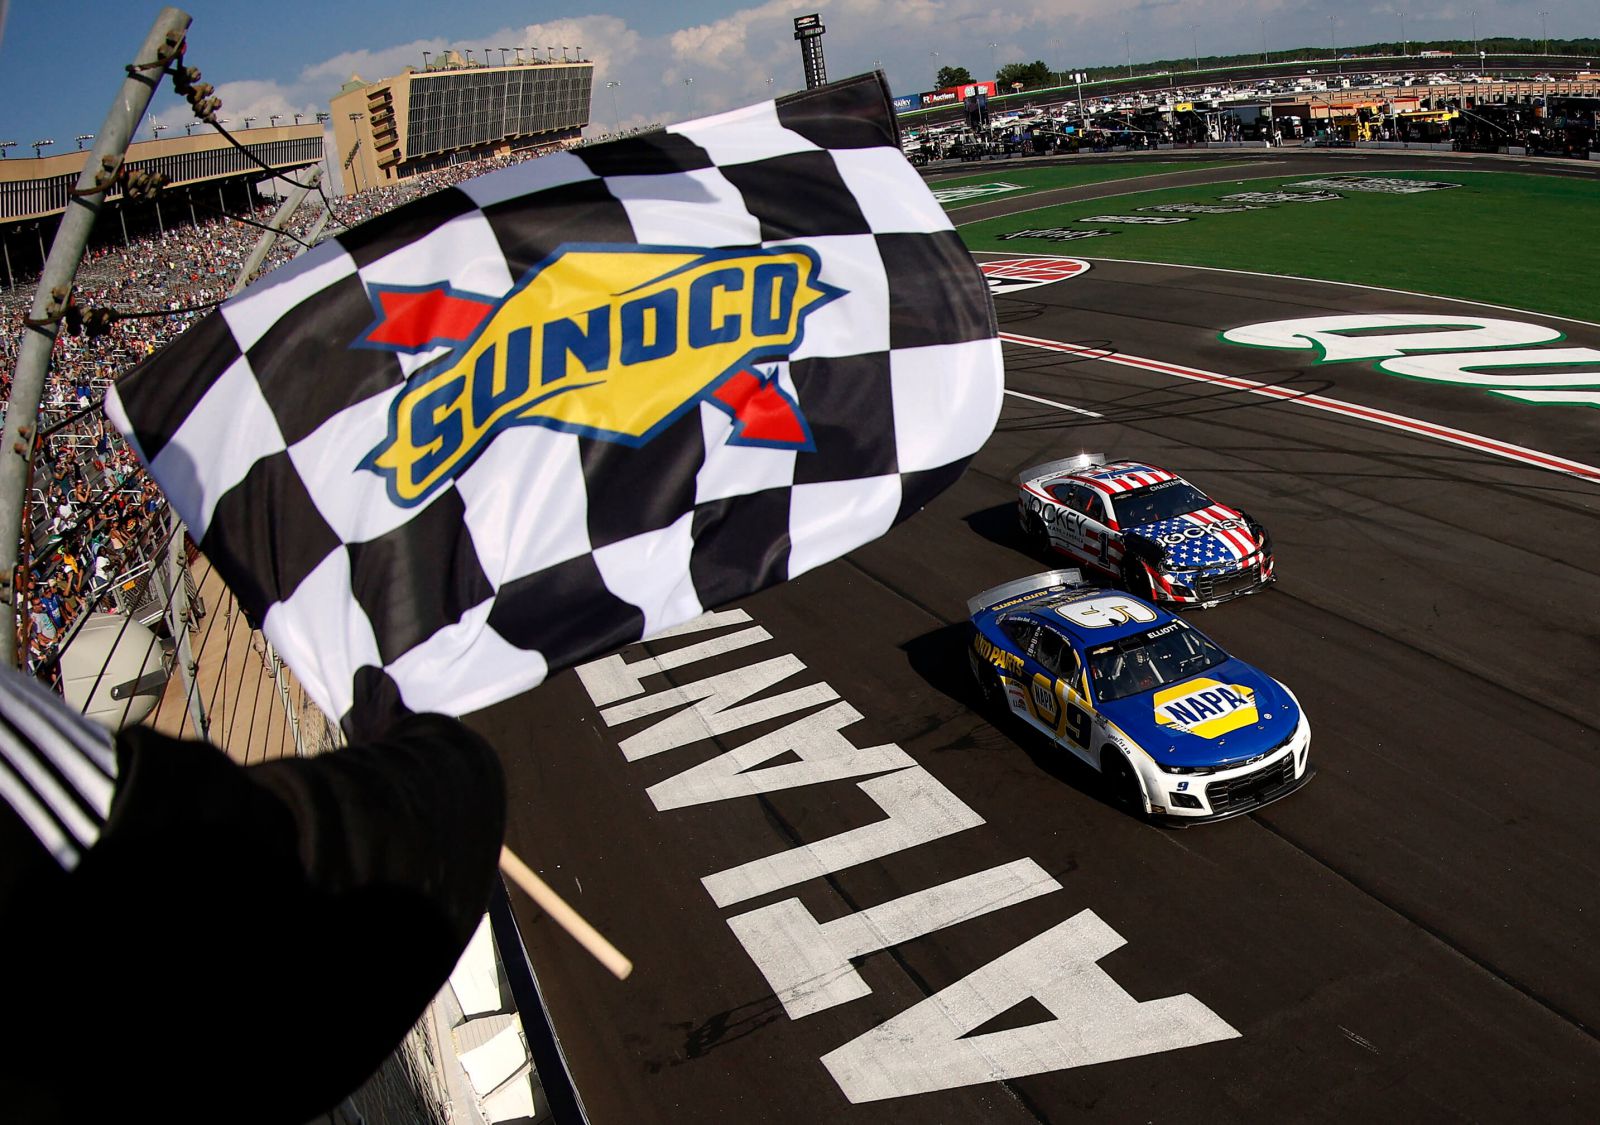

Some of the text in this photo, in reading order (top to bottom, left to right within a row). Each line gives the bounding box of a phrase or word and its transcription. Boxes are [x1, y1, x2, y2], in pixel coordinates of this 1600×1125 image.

[410, 263, 799, 486] SUNOCO
[1156, 517, 1248, 547] JOCKEY
[1098, 530, 1111, 570] 1
[1054, 595, 1158, 629] 9
[1147, 623, 1179, 639] ELLIOTT
[988, 646, 1025, 678] PARTS
[1035, 684, 1054, 713] NAPA
[1164, 687, 1248, 725] NAPA
[1066, 702, 1092, 750] 9
[1176, 781, 1189, 792] 9
